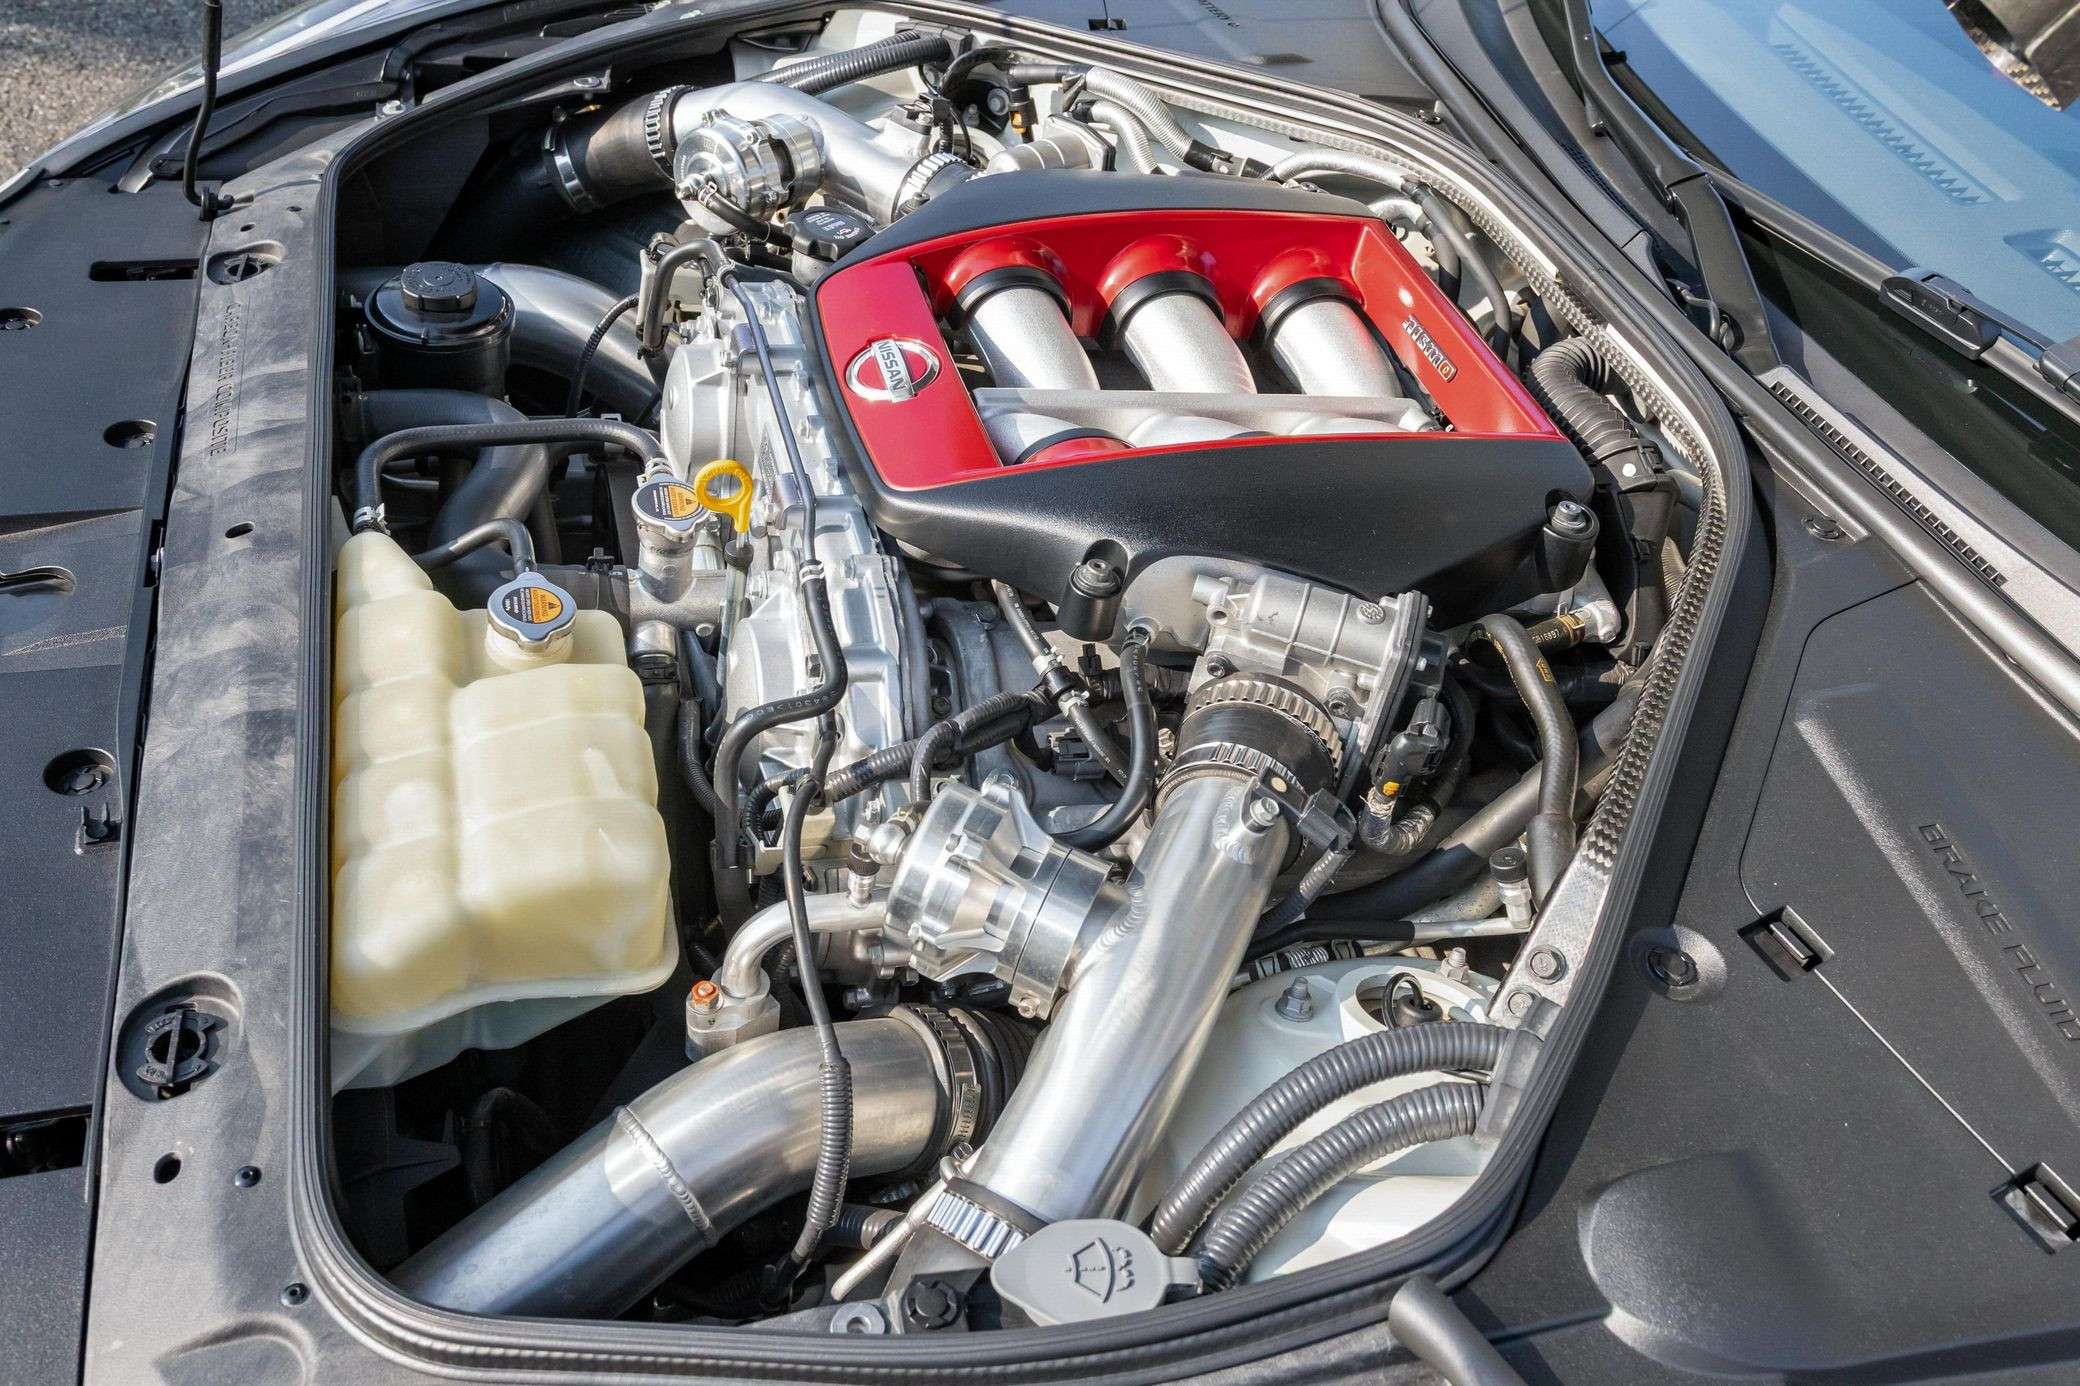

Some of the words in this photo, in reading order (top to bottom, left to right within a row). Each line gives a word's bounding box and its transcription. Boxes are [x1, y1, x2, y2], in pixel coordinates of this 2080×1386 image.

[876, 340, 907, 392] NISSAN
[1402, 314, 1456, 381] nismo
[210, 383, 234, 457] COMPOSITE
[1918, 823, 2013, 936] BRAKE
[2003, 943, 2080, 1041] FLUID
